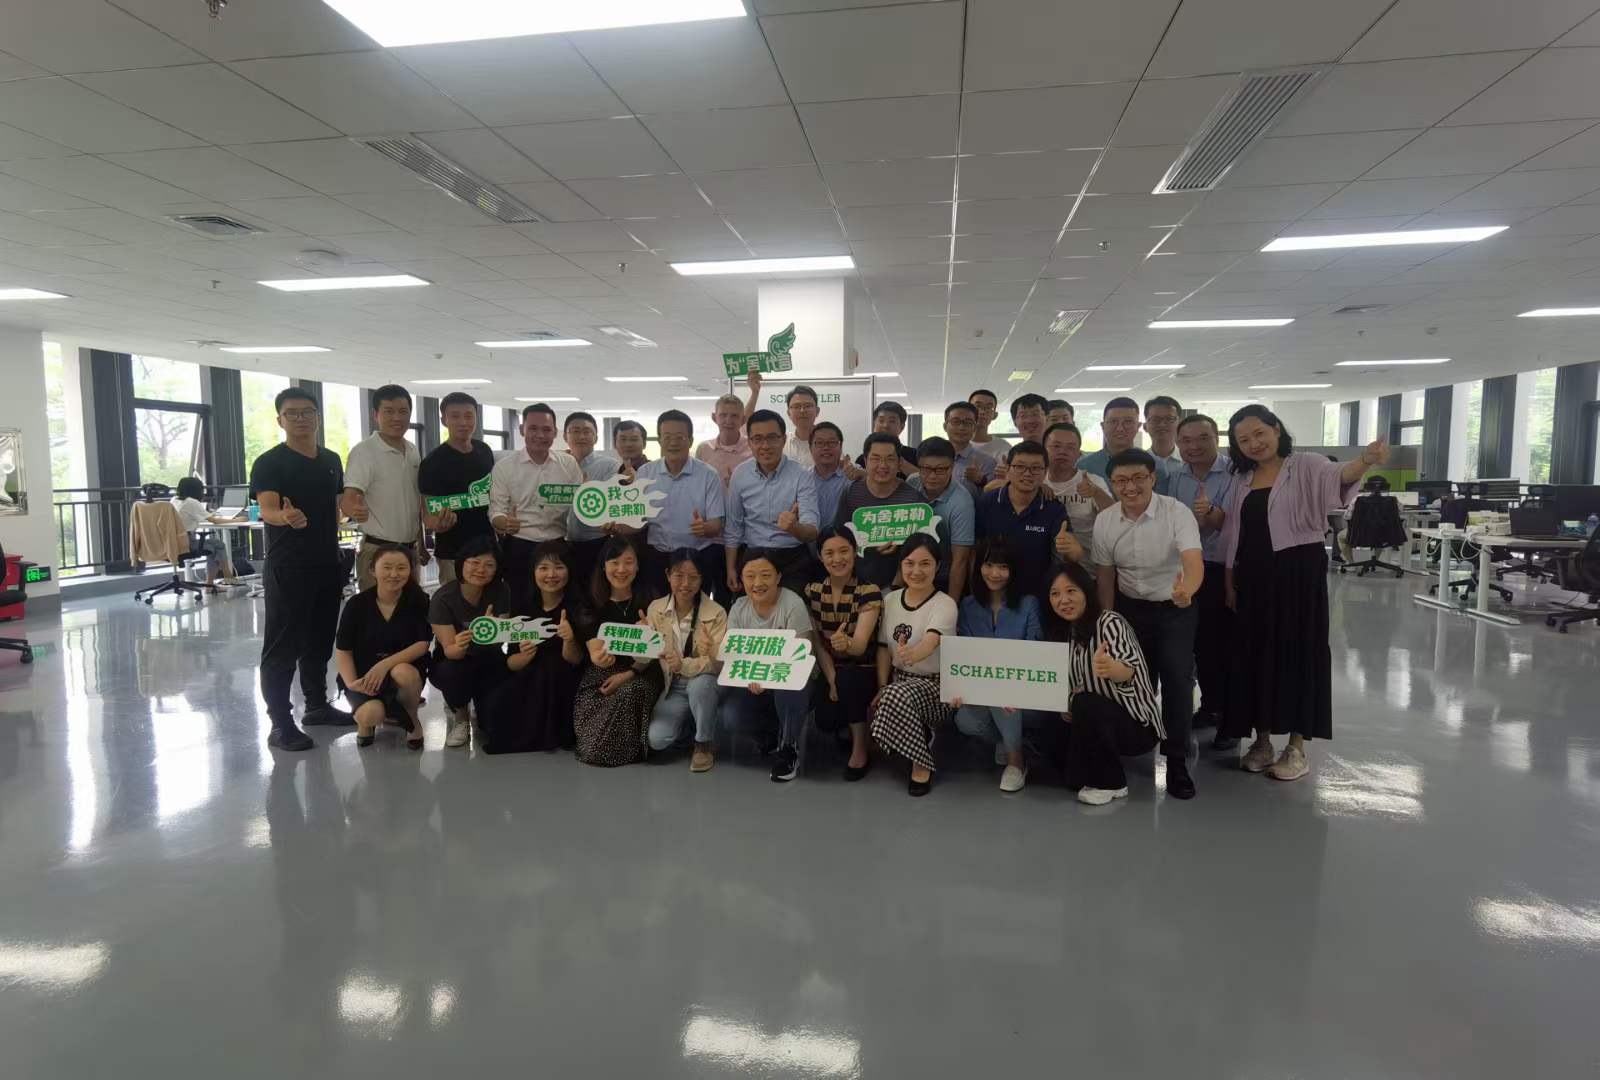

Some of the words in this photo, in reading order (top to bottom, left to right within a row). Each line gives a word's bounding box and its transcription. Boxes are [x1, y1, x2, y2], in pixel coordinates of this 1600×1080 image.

[607, 486, 621, 500] 我
[608, 504, 646, 517] 舍弗勒
[862, 507, 925, 524] 为舍弗勒
[500, 621, 511, 631] 我
[603, 626, 643, 639] 我骄傲
[609, 640, 648, 653] 我自豪
[725, 635, 785, 656] 我骄傲
[729, 660, 792, 682] 我自豪
[950, 664, 1057, 683] SCHAEFFLER
